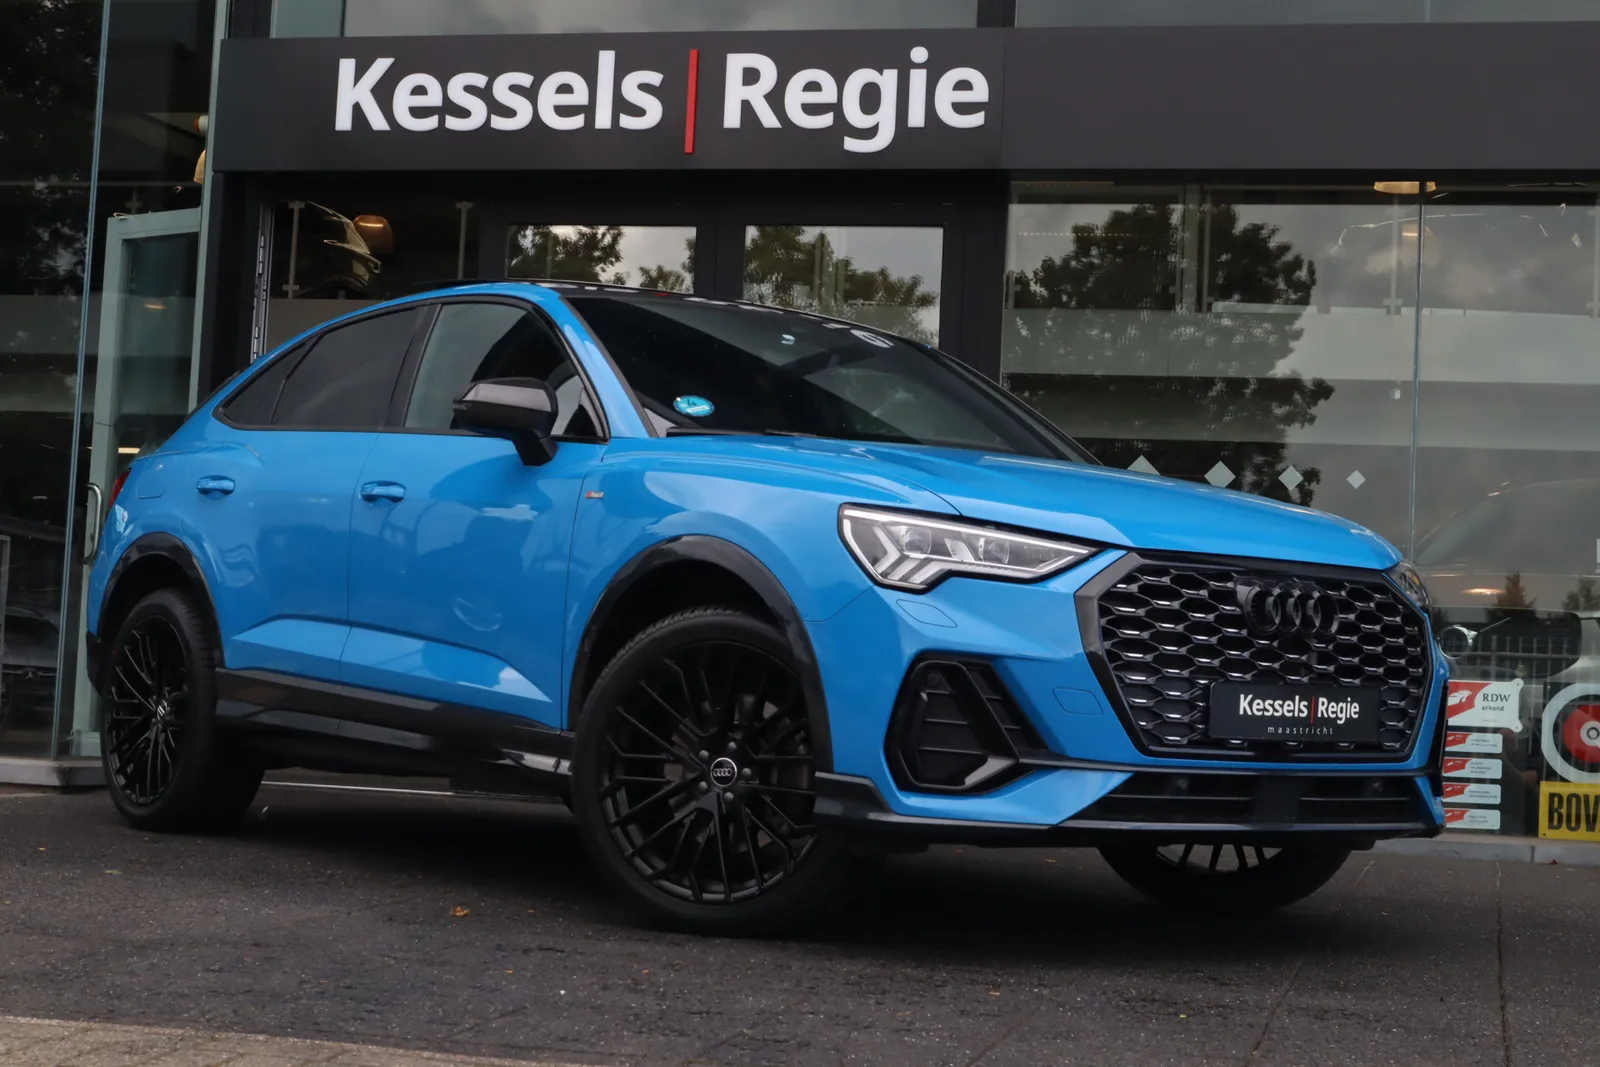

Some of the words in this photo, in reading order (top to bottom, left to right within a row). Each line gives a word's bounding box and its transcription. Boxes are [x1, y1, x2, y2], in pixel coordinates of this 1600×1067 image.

[335, 50, 664, 131] Kessels
[723, 46, 989, 153] Regie
[1239, 693, 1308, 717] Kessels
[1317, 697, 1360, 724] Regie
[1482, 693, 1511, 702] RDW
[1267, 726, 1333, 735] maastricht
[1548, 792, 1600, 832] BOV
